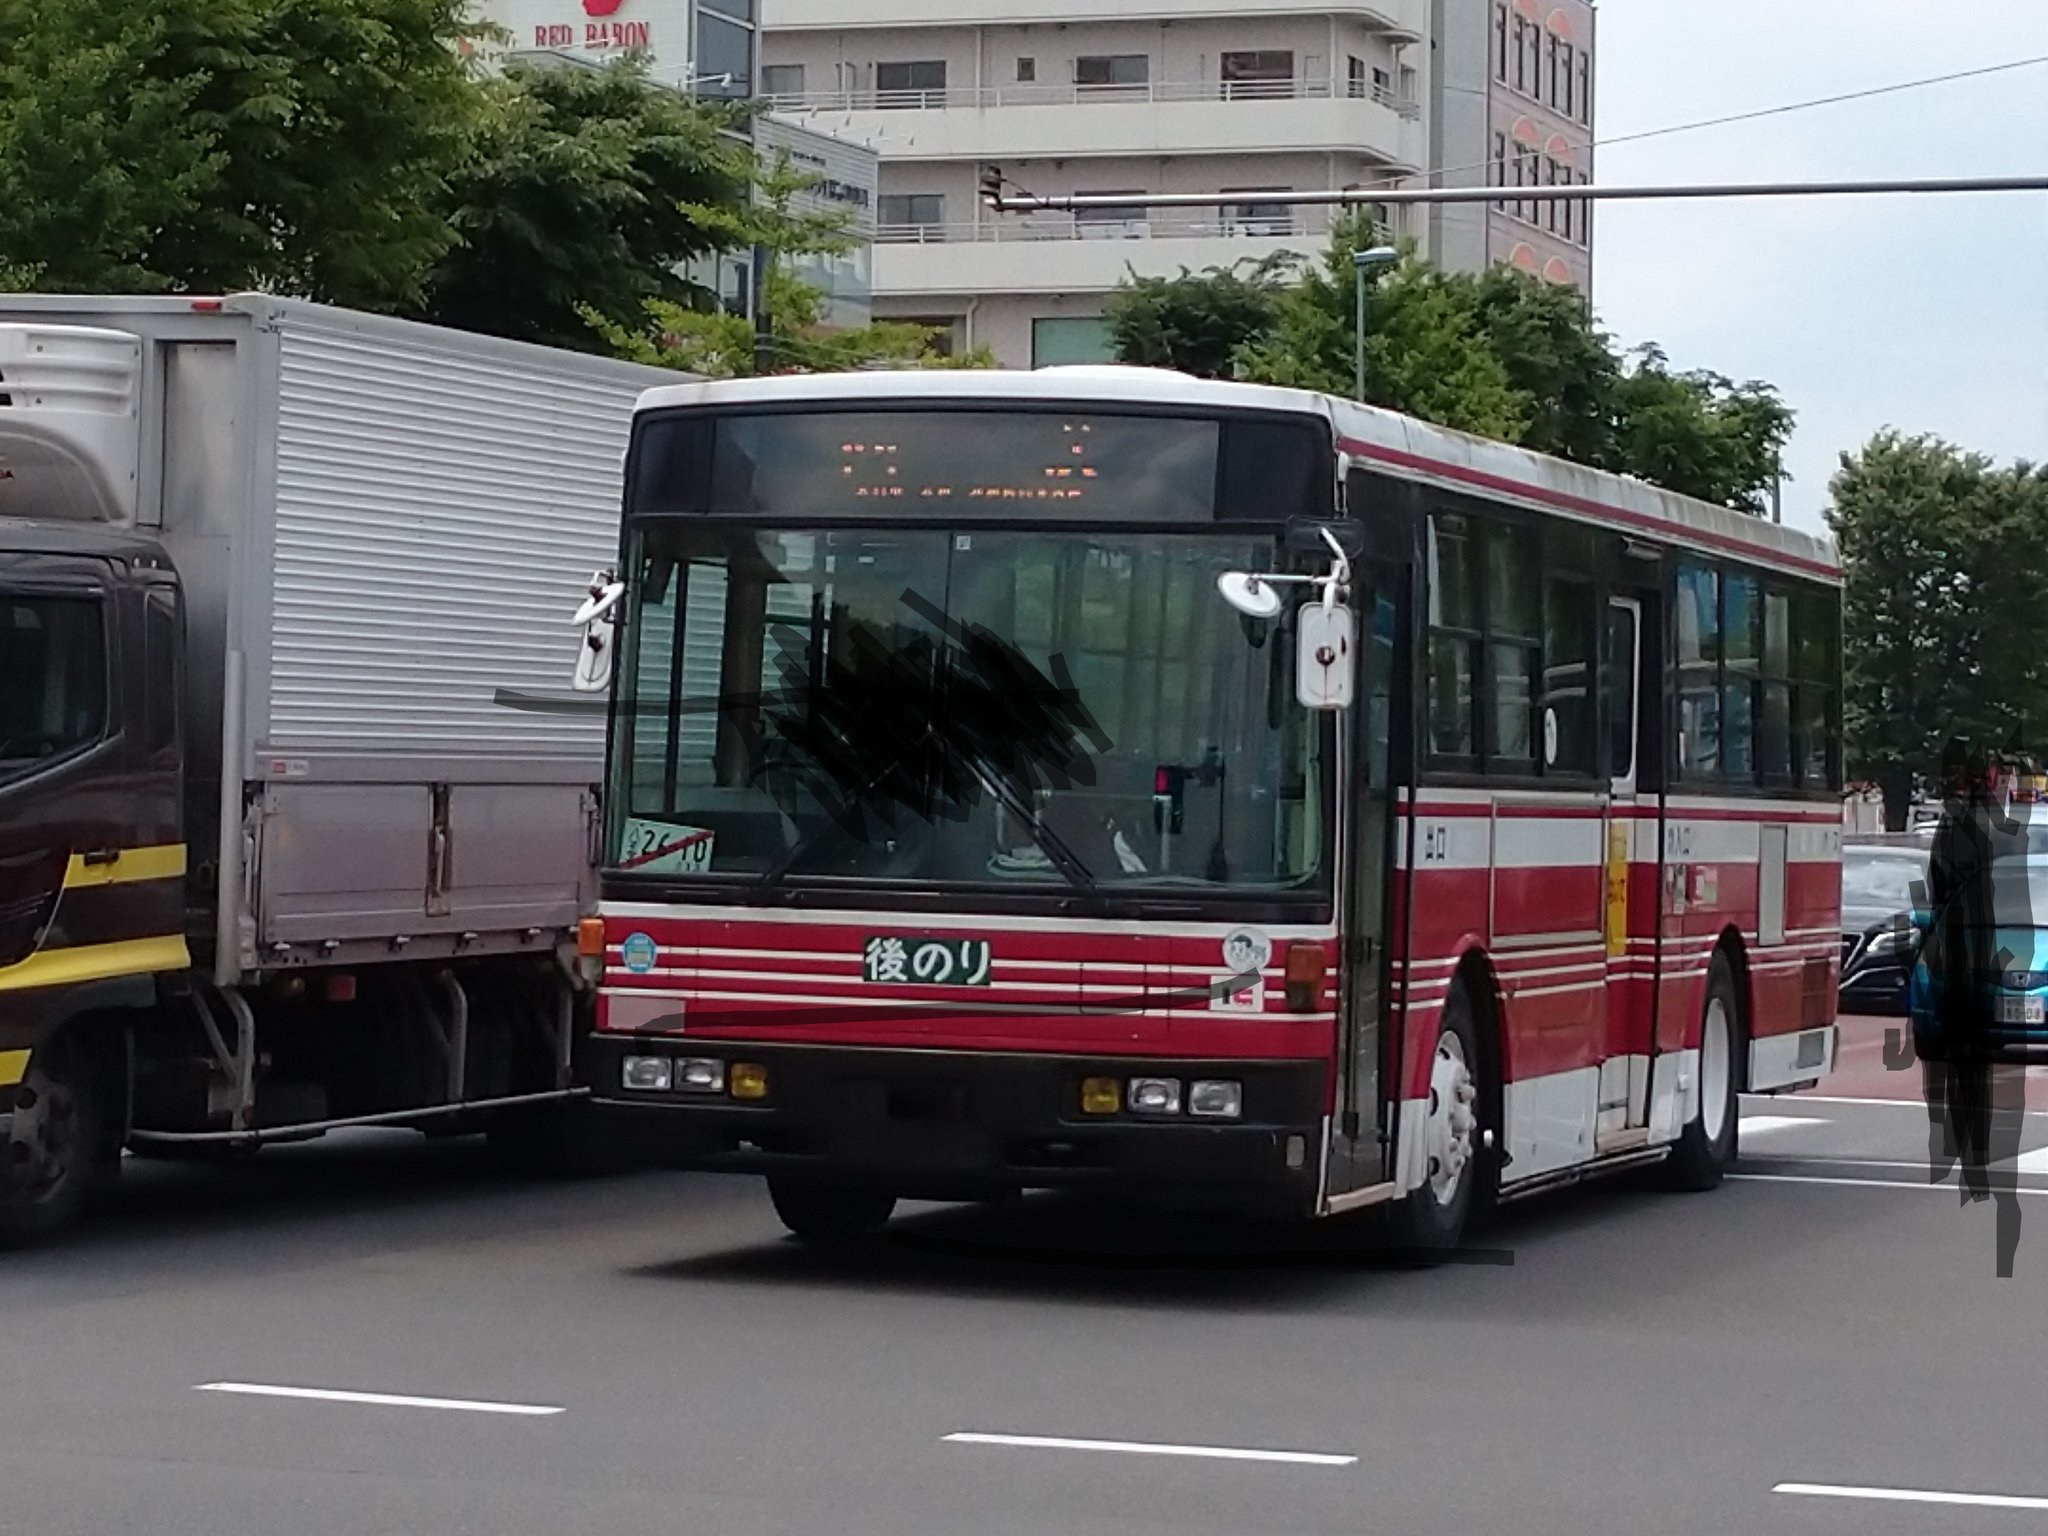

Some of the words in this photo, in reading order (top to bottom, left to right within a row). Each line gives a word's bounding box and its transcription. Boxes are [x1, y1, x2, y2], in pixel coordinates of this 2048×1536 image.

[535, 25, 573, 47] RED
[585, 22, 650, 48] BARON
[865, 937, 989, 984] 後のり
